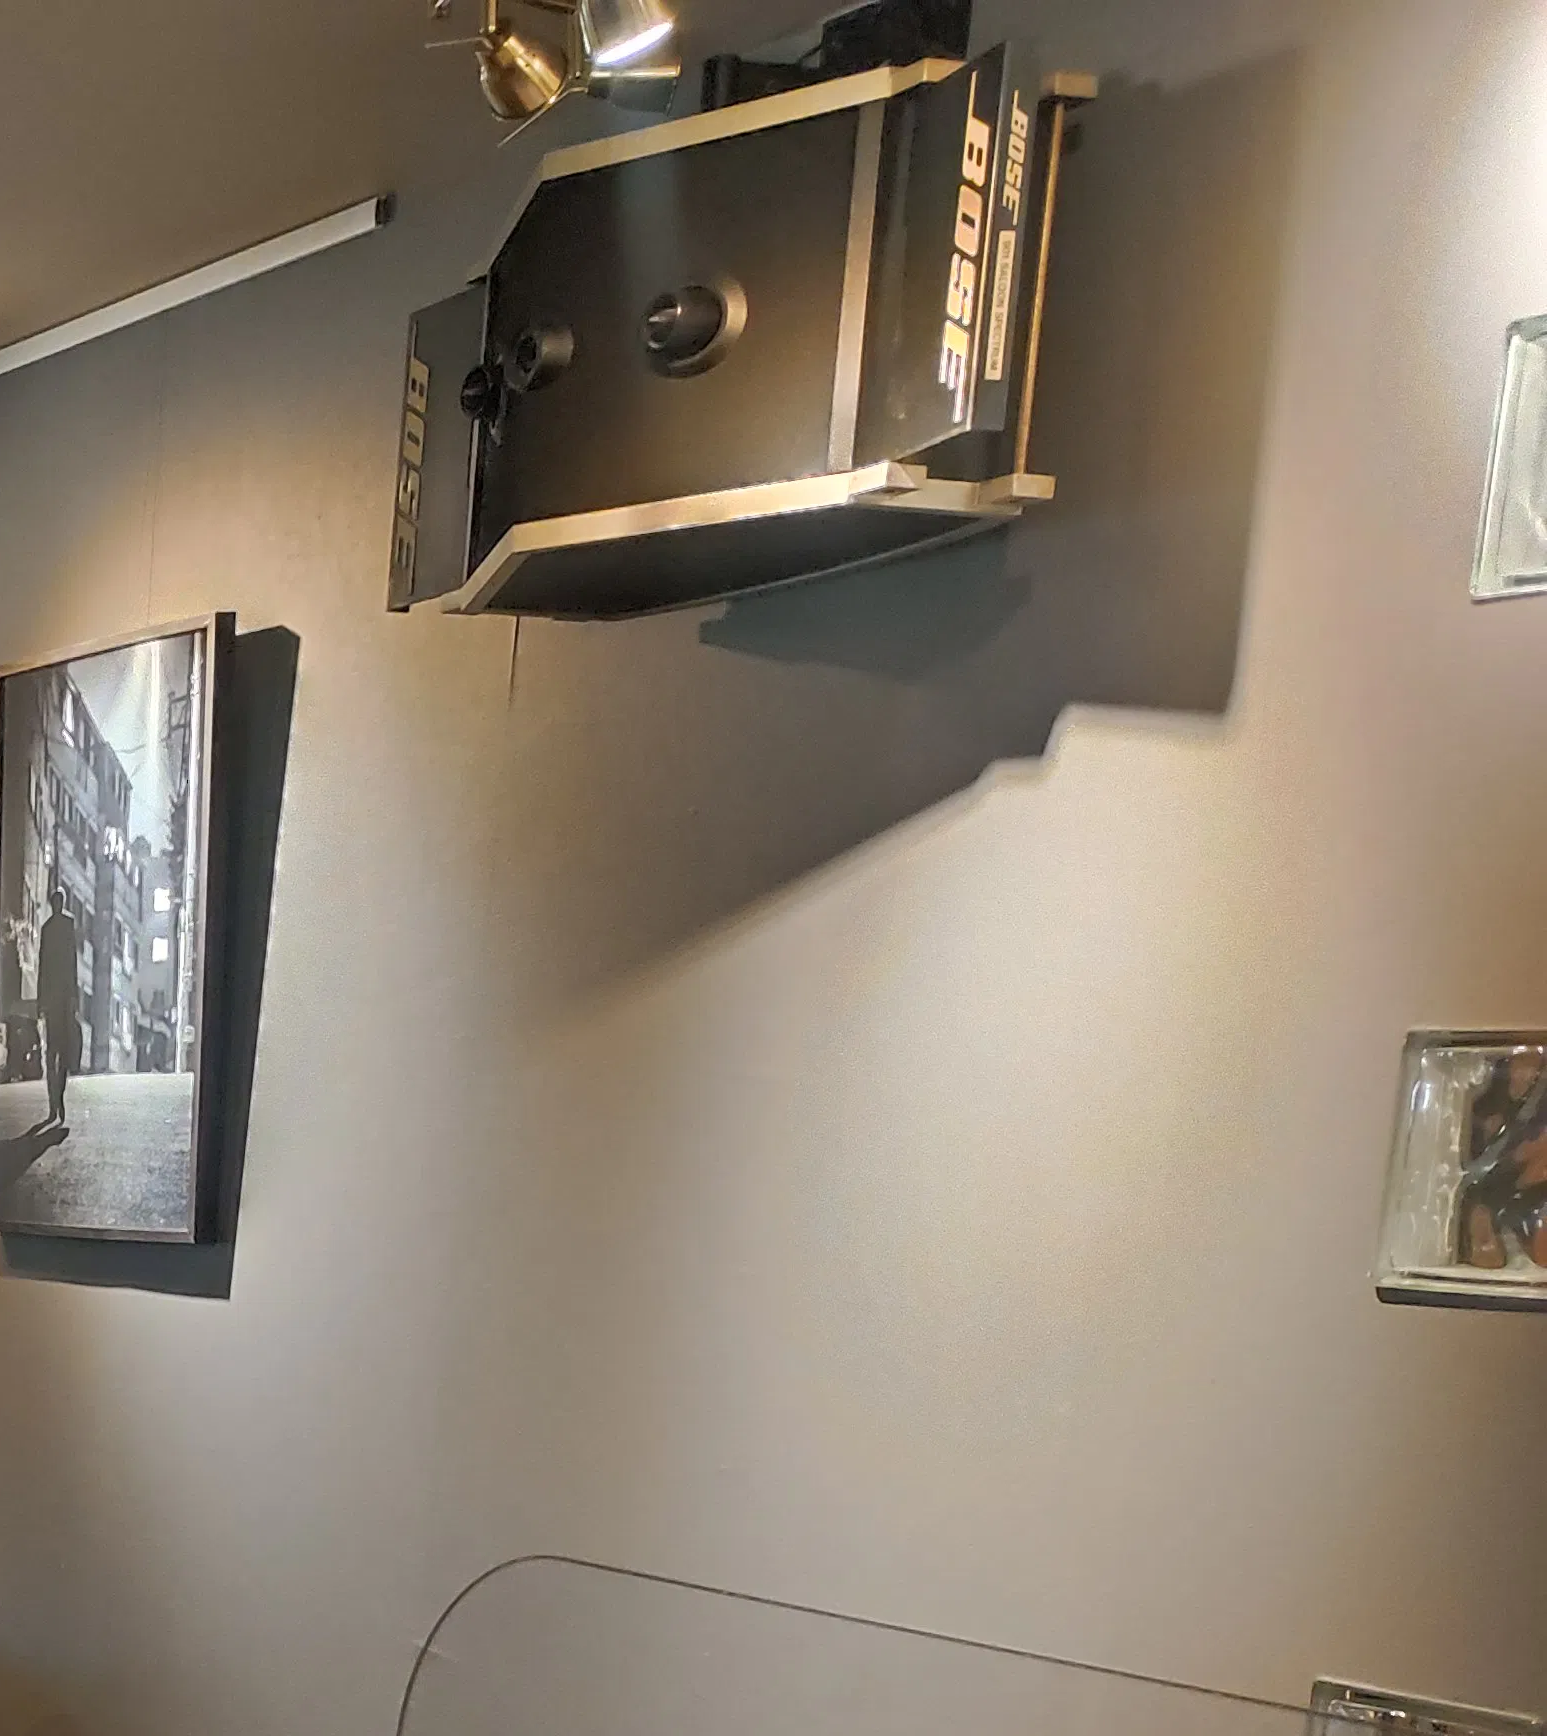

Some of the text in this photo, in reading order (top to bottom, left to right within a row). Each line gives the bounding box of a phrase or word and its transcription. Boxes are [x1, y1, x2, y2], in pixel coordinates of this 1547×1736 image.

[938, 72, 992, 422] BOSE
[1002, 89, 1028, 226] BOSE
[393, 324, 430, 596] BOSE
